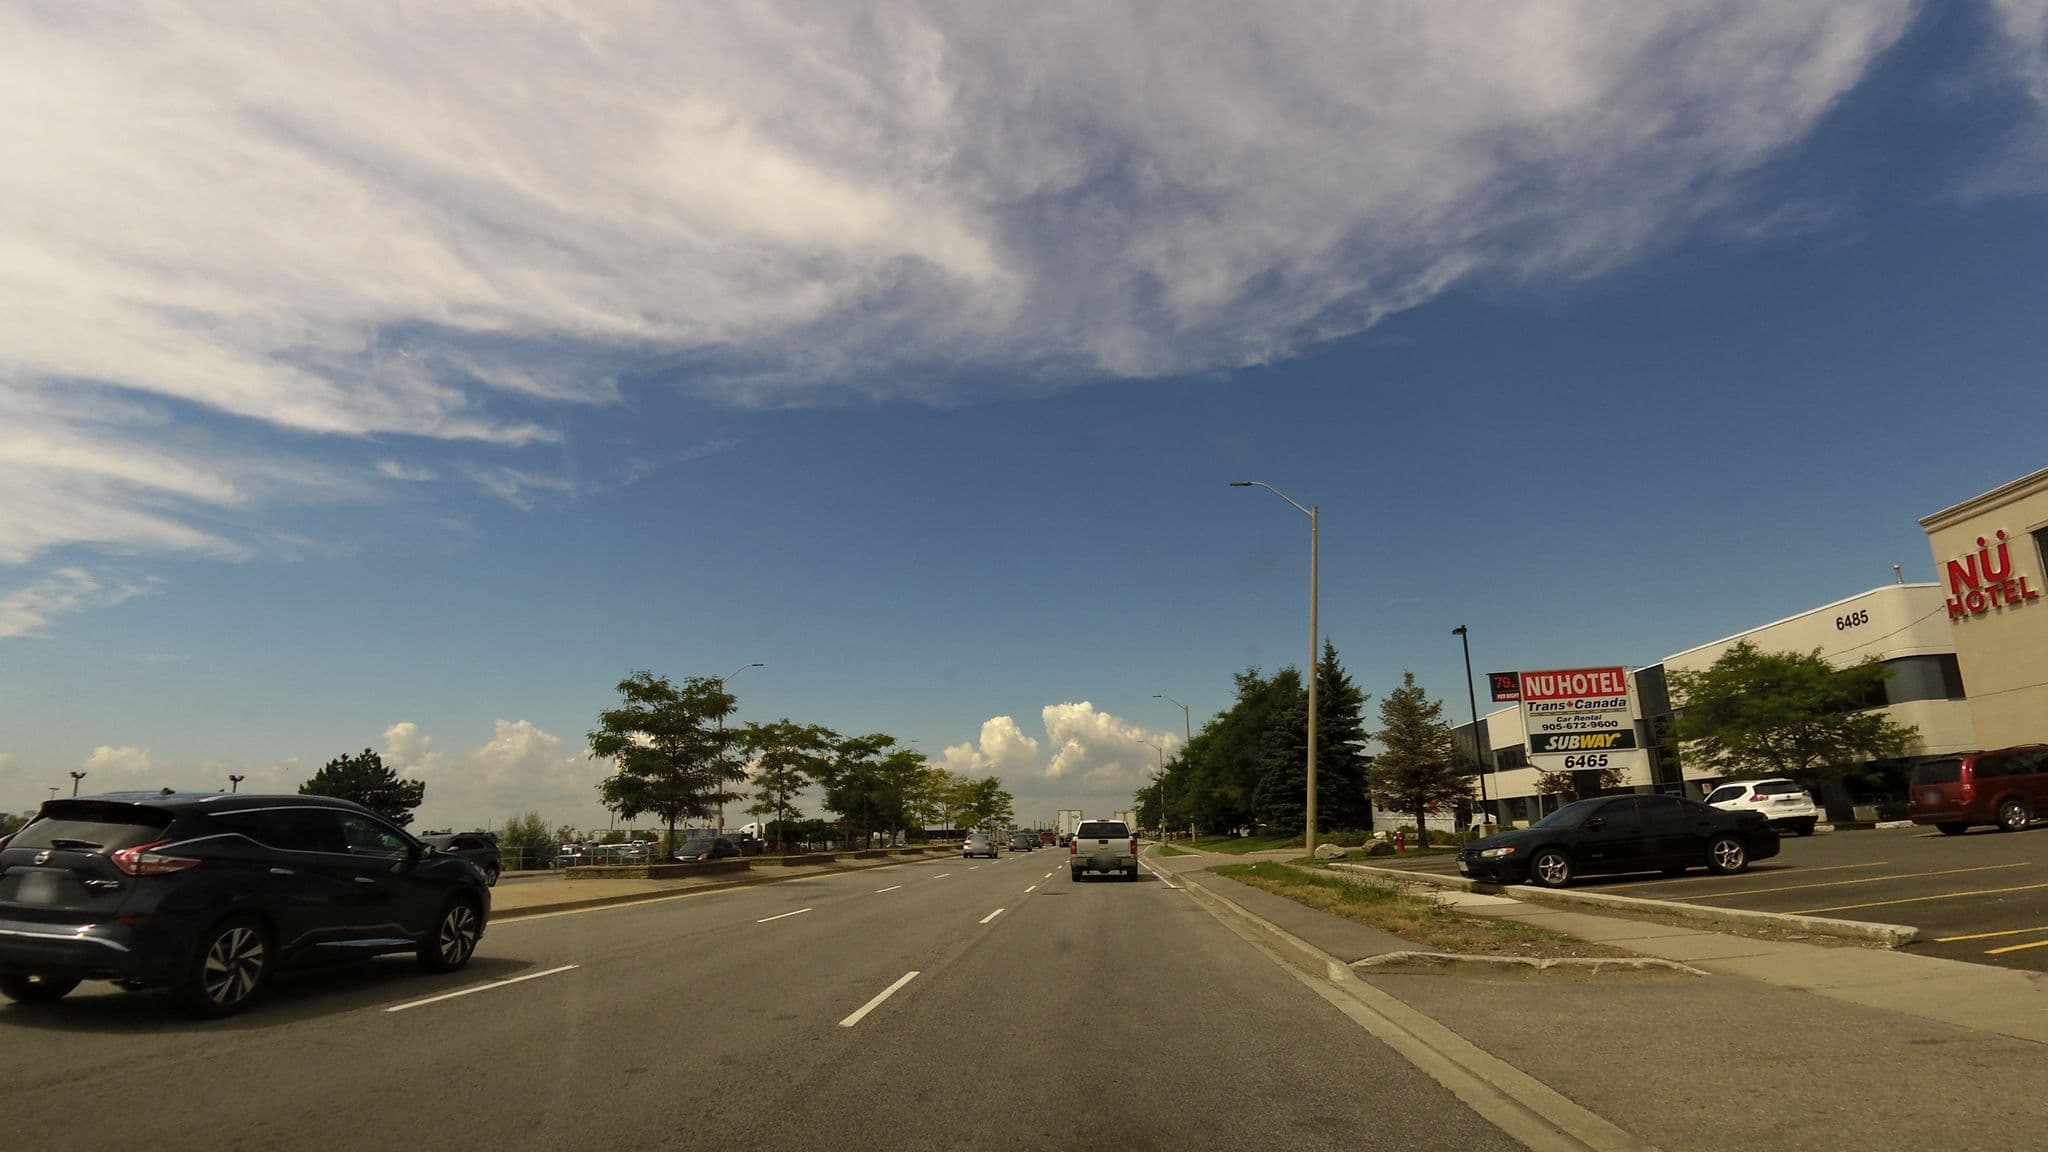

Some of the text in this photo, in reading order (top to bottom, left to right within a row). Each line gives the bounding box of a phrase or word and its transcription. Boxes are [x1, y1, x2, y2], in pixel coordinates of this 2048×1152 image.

[1947, 530, 2011, 594] NÜ
[1946, 577, 2039, 619] HOTEL
[1836, 610, 1869, 630] 6485
[1558, 672, 1624, 695] HOTEL
[1528, 698, 1626, 711] Trans Canada
[1542, 720, 1618, 731] 905-672-9600
[1574, 714, 1602, 722] Rental
[1545, 733, 1621, 750] SUBWAY
[1565, 754, 1608, 768] 6465
